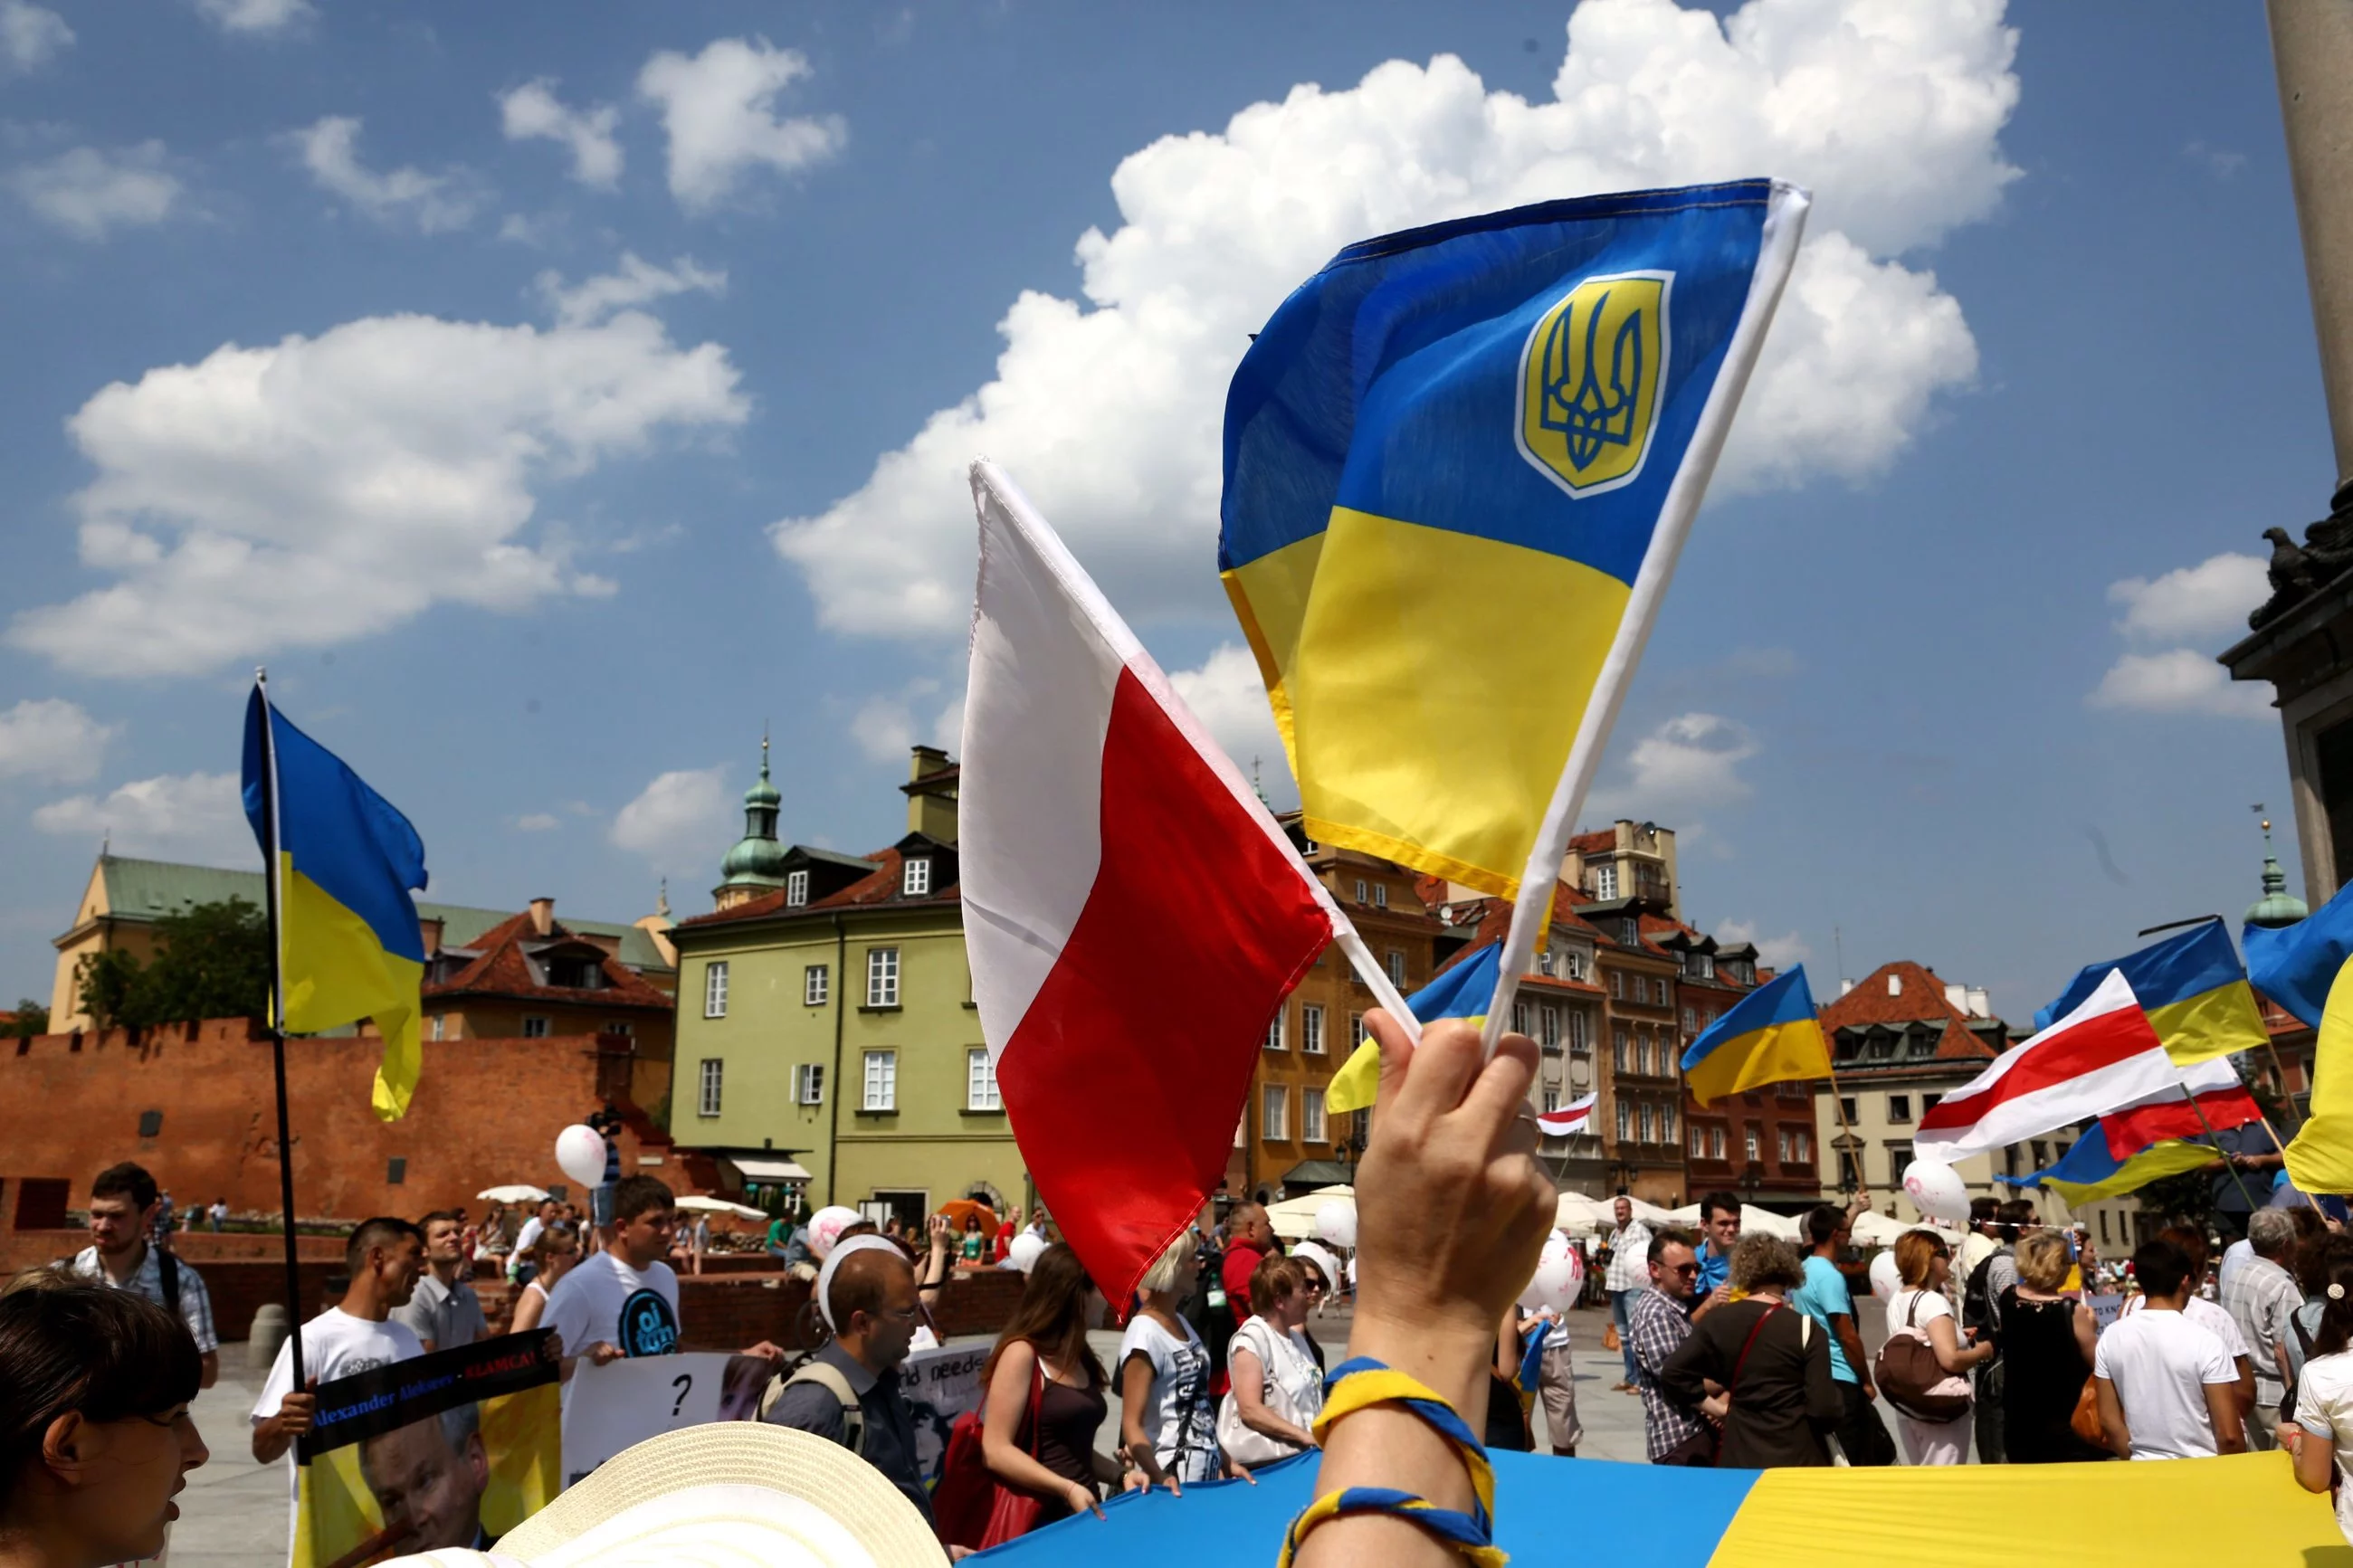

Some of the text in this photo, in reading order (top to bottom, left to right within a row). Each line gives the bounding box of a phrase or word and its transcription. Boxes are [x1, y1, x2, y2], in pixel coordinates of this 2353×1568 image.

[930, 1355, 984, 1382] needs
[314, 1392, 396, 1429] Alexander
[672, 1373, 692, 1417] ?
